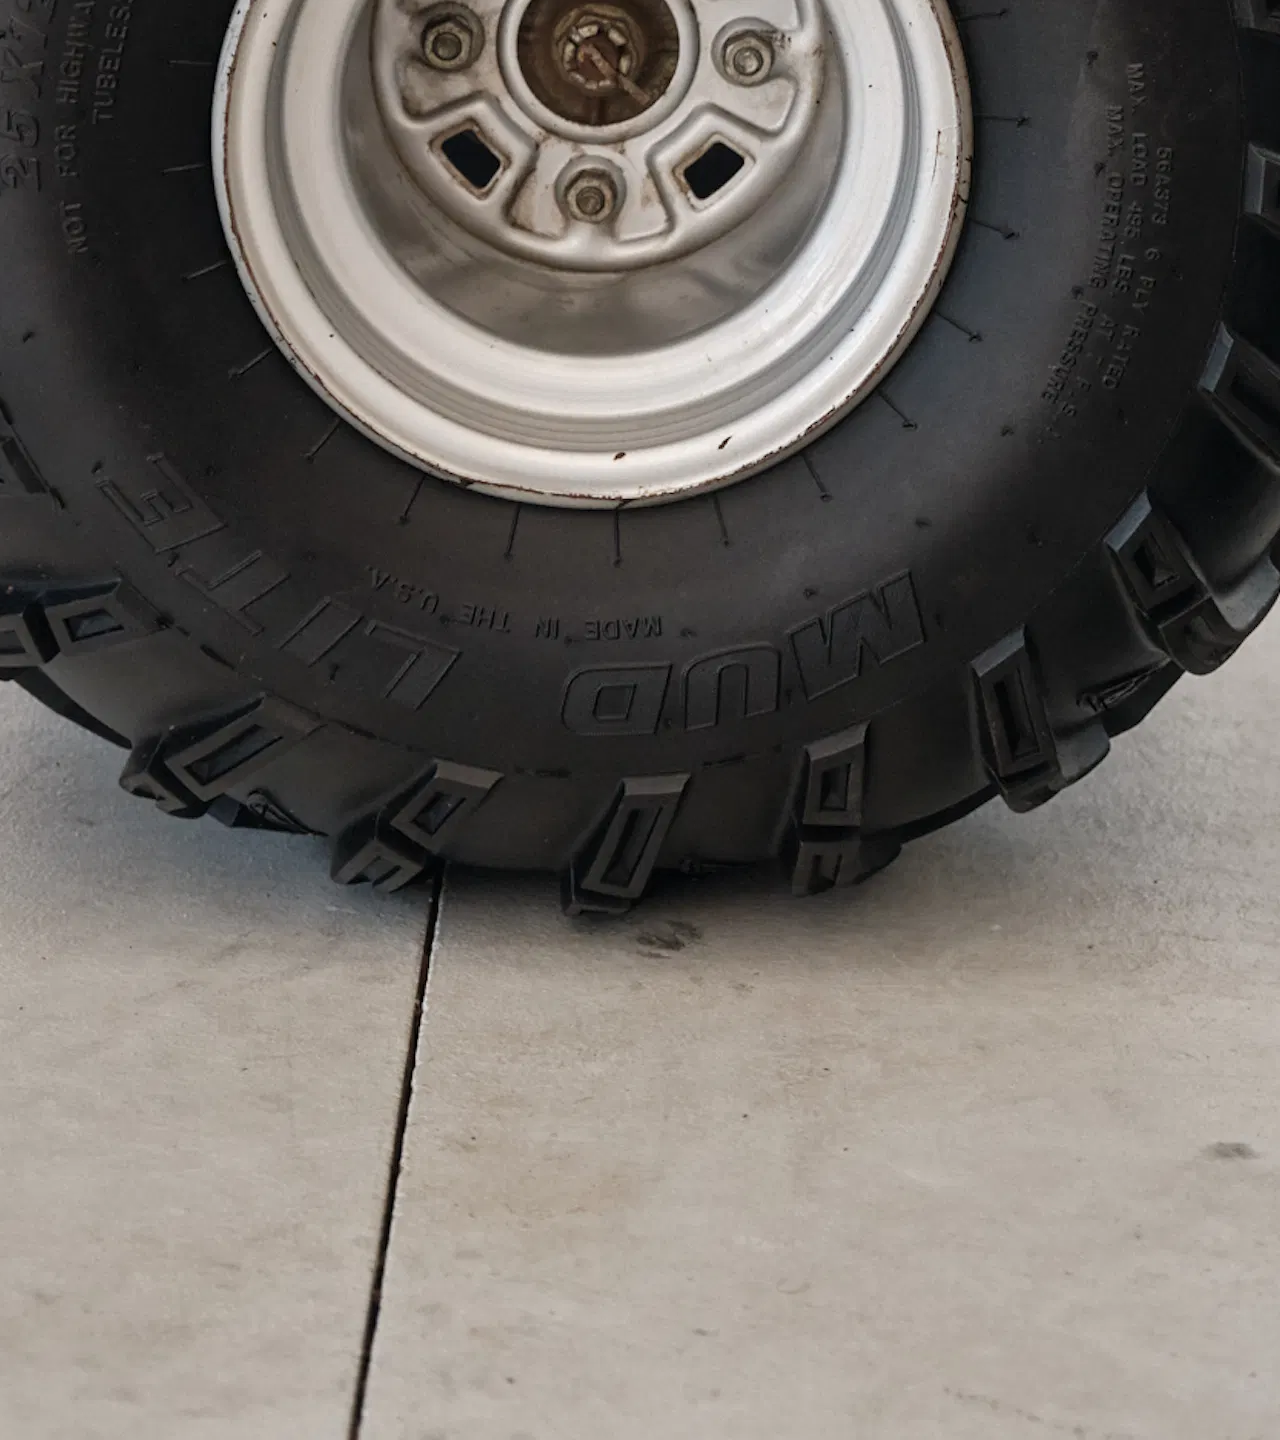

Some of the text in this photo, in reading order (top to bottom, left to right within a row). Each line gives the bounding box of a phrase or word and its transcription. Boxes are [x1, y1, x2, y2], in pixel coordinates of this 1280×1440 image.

[55, 123, 79, 178] FOR
[1130, 132, 1148, 186] LOAD
[59, 200, 90, 255] NOT
[1089, 172, 1126, 289] OPERATING
[1042, 301, 1098, 405] PRESSURE
[93, 452, 927, 738] MUD LITE
[454, 600, 514, 635] THE
[533, 615, 561, 641] IN
[584, 614, 664, 642] MADE
